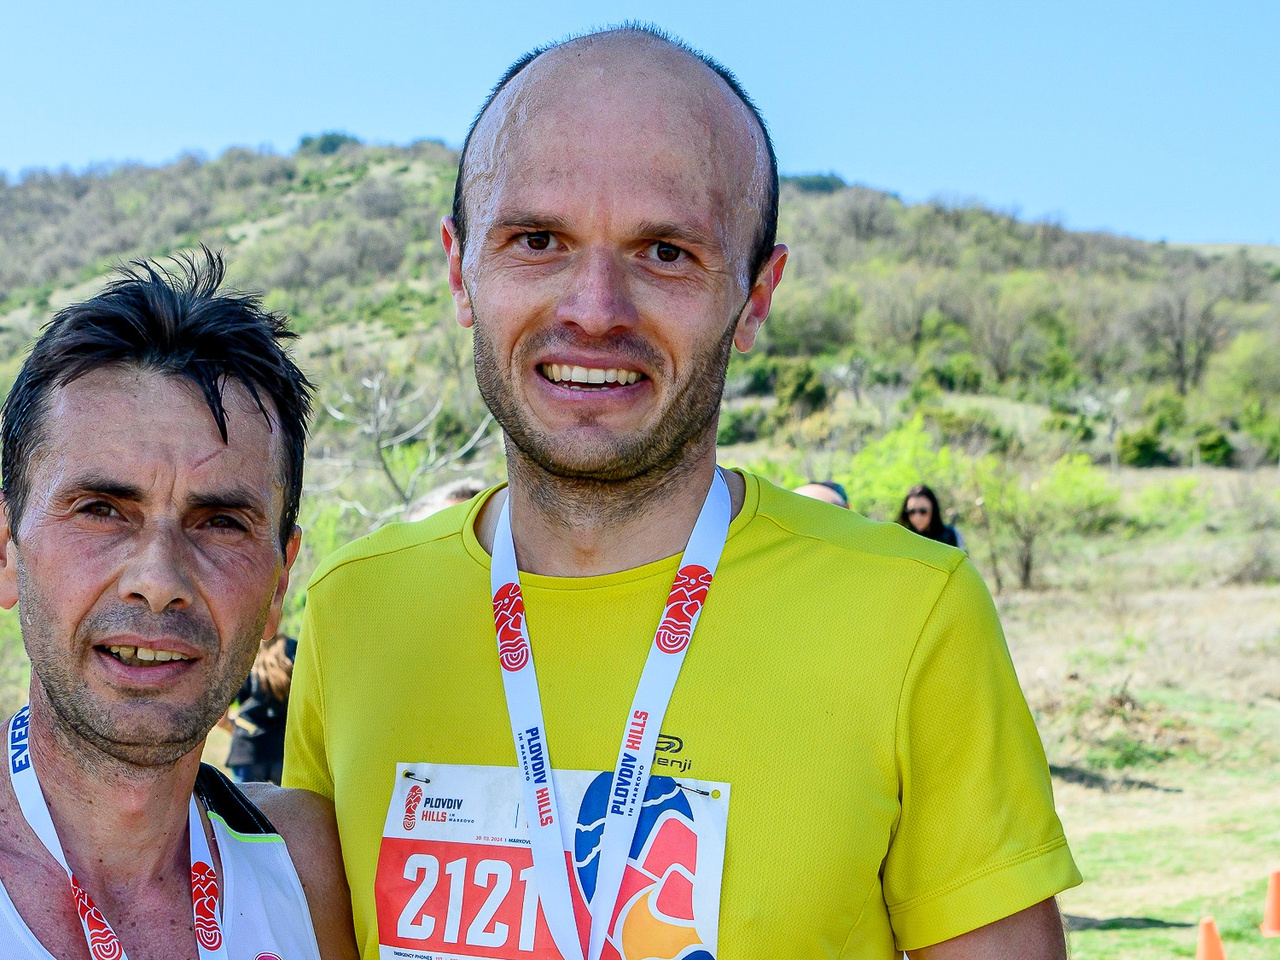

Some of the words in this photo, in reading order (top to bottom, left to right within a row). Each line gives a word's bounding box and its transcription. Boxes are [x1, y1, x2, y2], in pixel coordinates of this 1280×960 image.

[518, 732, 523, 741] IN
[520, 744, 530, 781] MARKOVO
[525, 727, 547, 783] PLOVDIV
[536, 787, 554, 827] HILLS
[611, 752, 637, 815] PLOVDIV
[626, 710, 648, 750] HILLS
[424, 797, 463, 810] PLOVDIV
[628, 808, 634, 816] IN
[631, 765, 644, 804] MARKOVO
[421, 810, 447, 822] HILLS
[397, 854, 540, 952] 2121
